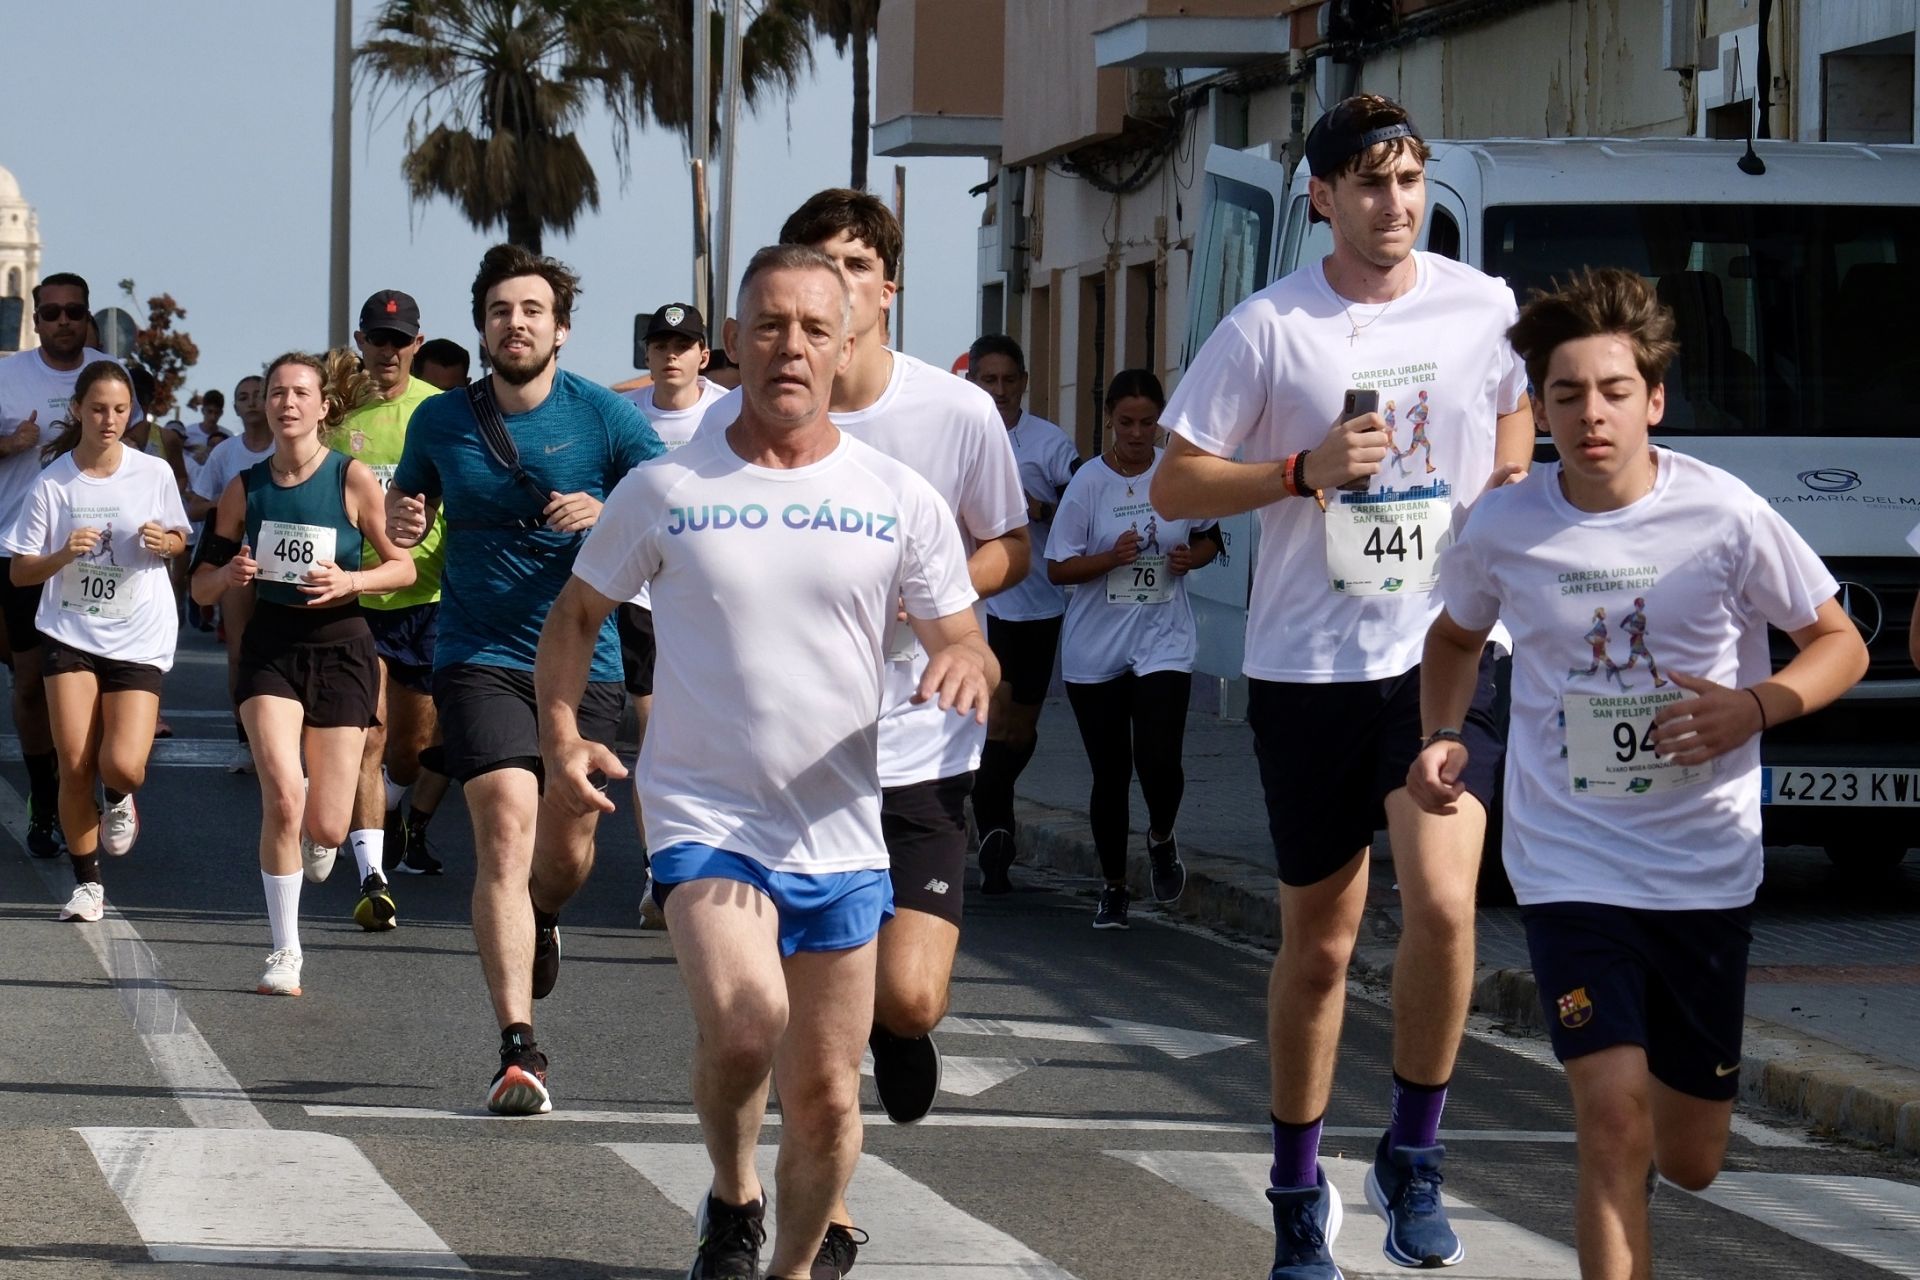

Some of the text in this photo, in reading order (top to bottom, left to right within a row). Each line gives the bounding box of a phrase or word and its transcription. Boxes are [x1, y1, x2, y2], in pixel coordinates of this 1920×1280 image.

[1351, 361, 1439, 381] CARRERA URBANA
[1355, 372, 1436, 390] SAN FELIPE NERI
[1350, 501, 1431, 514] CARRERA URBANA
[1797, 494, 1858, 503] MARÍA
[1863, 495, 1896, 504] DEL
[273, 522, 297, 530] CARRERA
[667, 498, 898, 544] JUDO CÁDIZ
[1353, 511, 1428, 524] SAN FELIPE NERI
[284, 530, 304, 538] FELIPE
[273, 537, 314, 564] 468
[1363, 524, 1423, 563] 441
[1132, 567, 1155, 587] 76
[1558, 565, 1659, 583] CARRERA URBANA
[80, 575, 116, 600] 103
[1561, 577, 1655, 596] SAN FELIPE NERI
[1589, 691, 1683, 707] CARRERA URBANA
[1592, 708, 1612, 719] SAN
[1616, 707, 1652, 718] FELIPE
[1778, 771, 1859, 801] 4223
